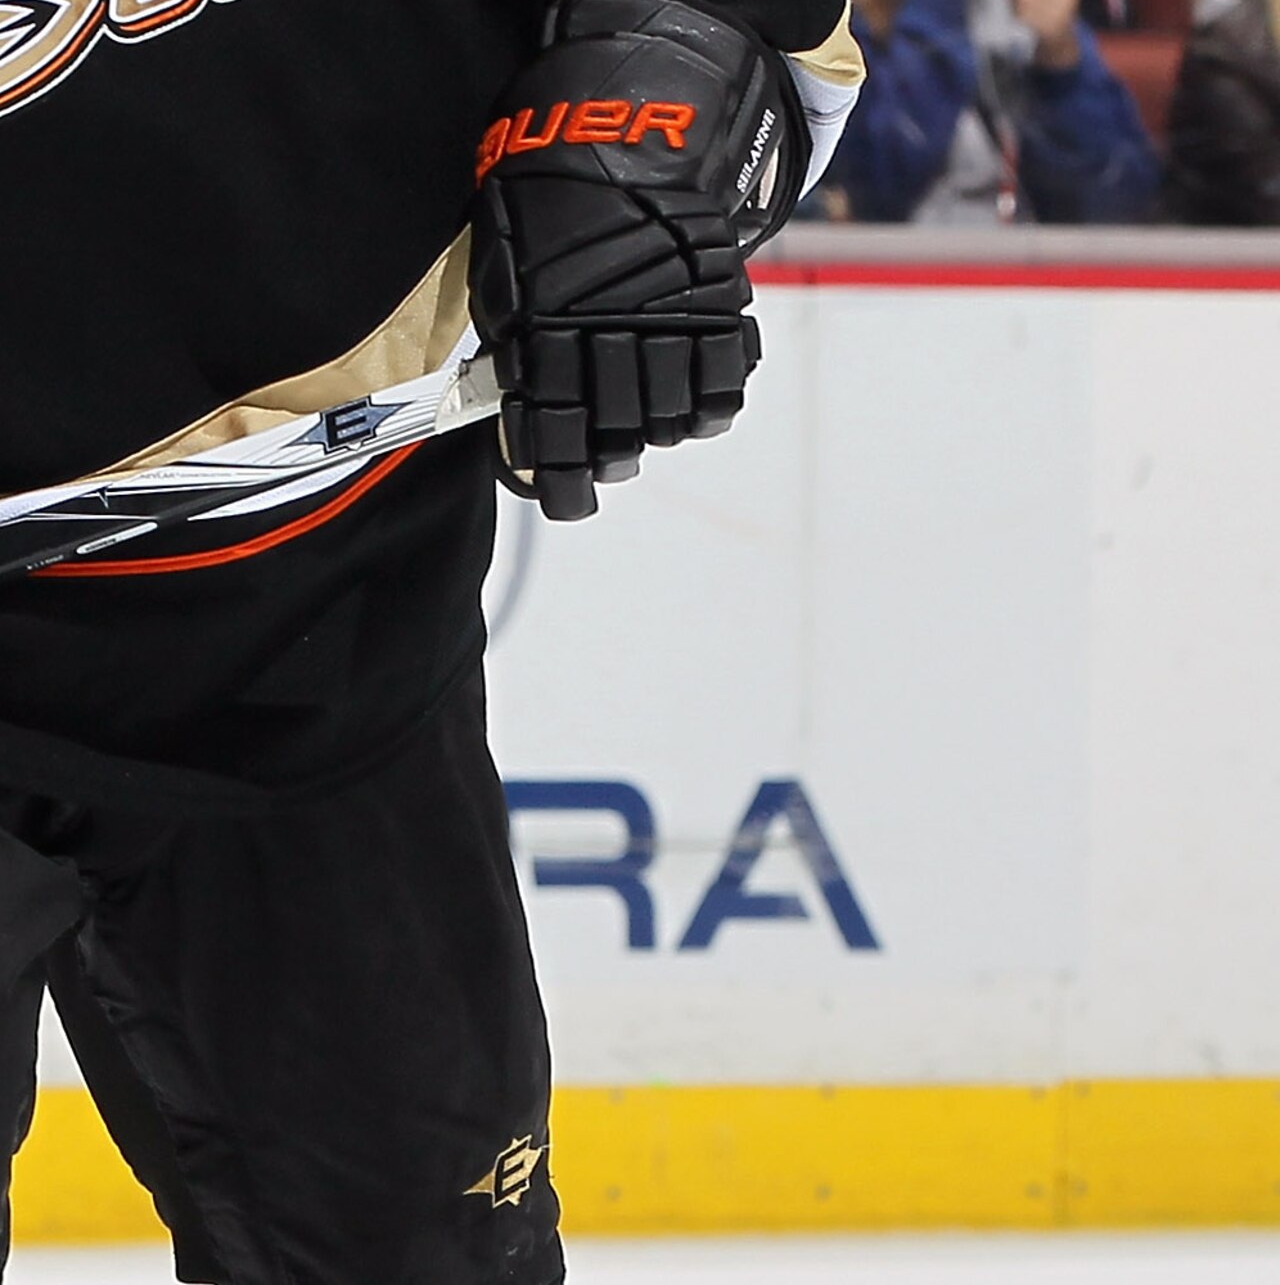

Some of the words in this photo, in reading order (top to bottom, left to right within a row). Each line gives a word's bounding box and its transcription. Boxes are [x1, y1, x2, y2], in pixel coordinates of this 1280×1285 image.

[475, 99, 697, 189] AUER
[326, 399, 372, 449] E
[494, 1139, 529, 1202] E
